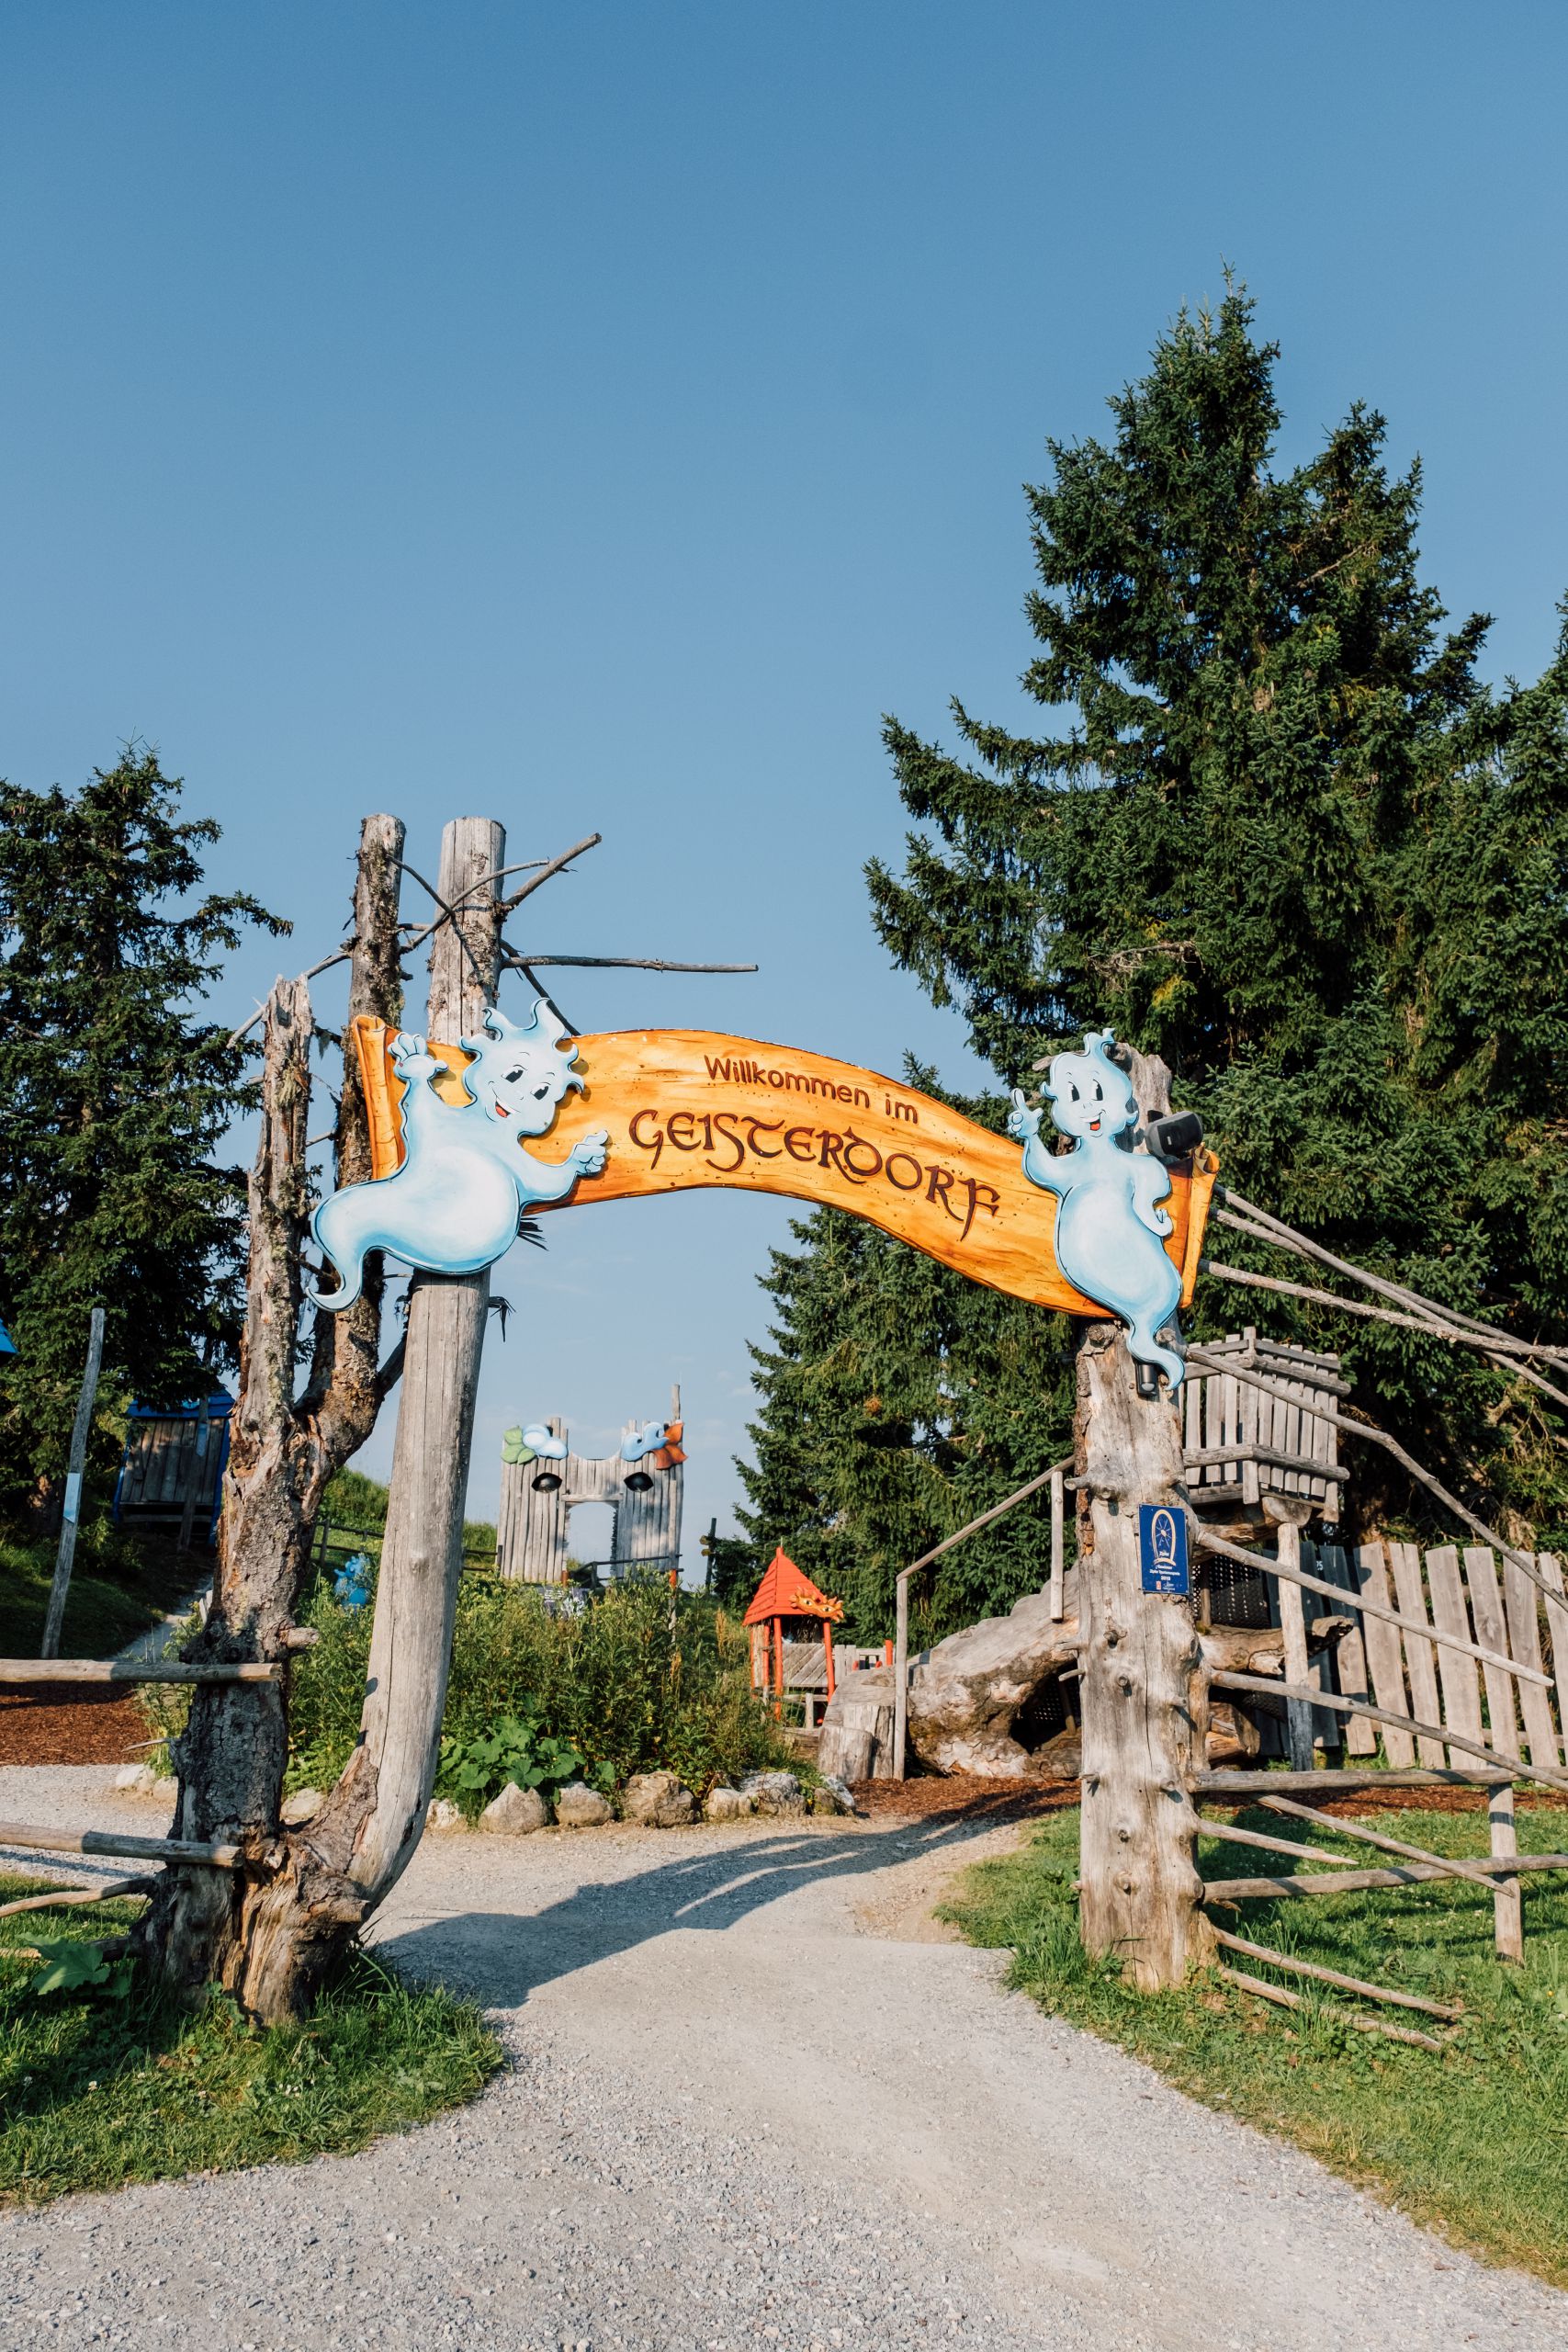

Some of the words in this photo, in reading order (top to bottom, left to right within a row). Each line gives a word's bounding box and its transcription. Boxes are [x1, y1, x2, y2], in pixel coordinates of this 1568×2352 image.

[705, 1054, 870, 1109] Willkommen
[885, 1093, 919, 1124] im
[628, 1108, 1001, 1242] GEISTERDORF
